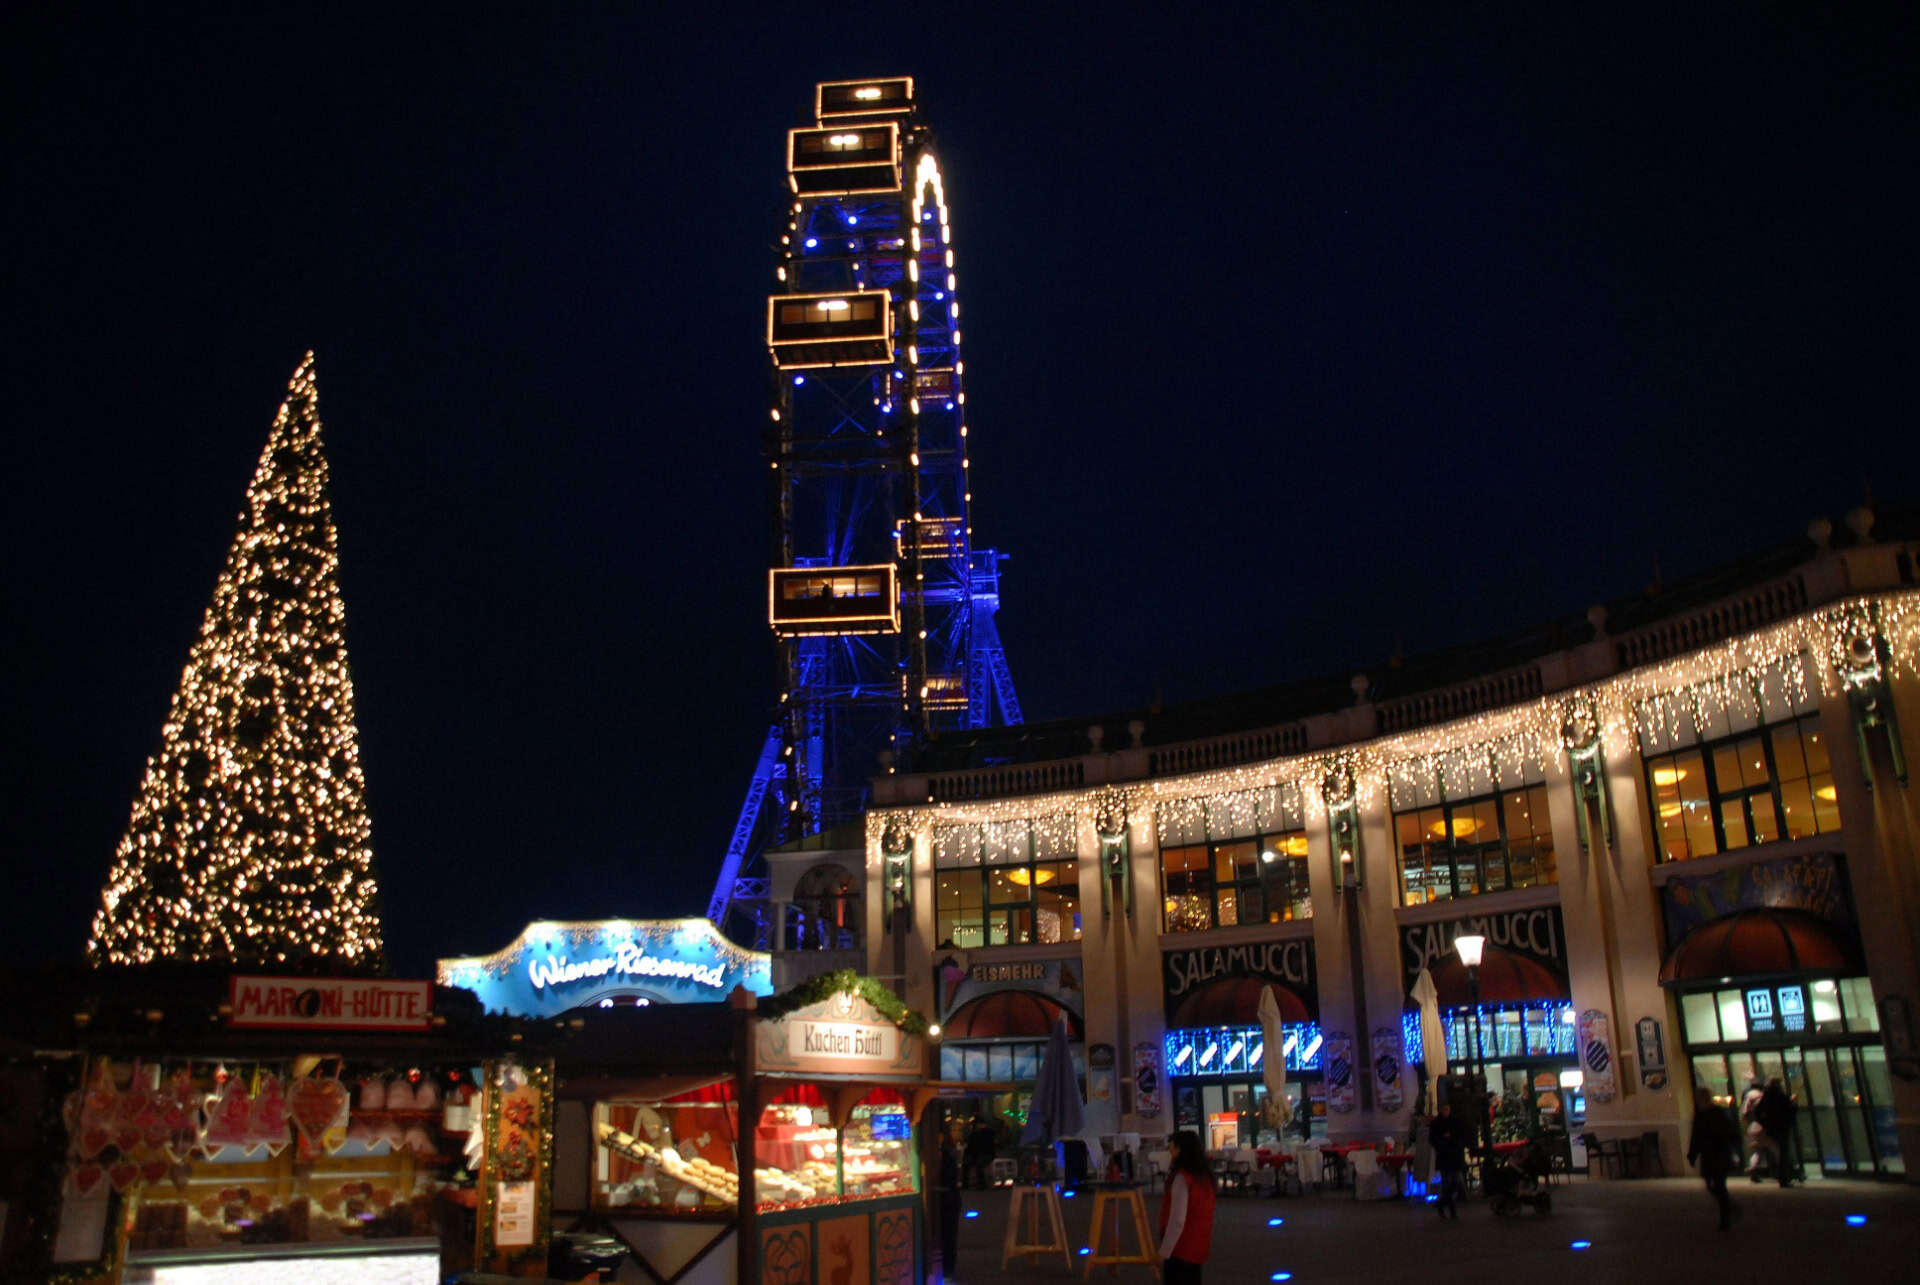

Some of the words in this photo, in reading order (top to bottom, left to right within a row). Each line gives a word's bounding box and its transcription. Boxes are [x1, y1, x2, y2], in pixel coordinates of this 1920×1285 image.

[529, 954, 617, 988] Wiener
[614, 943, 726, 988] Riesenrad
[973, 963, 1046, 981] EISMEHR
[1168, 940, 1309, 995] SALAMUCCI
[804, 1023, 850, 1054] Kuchen
